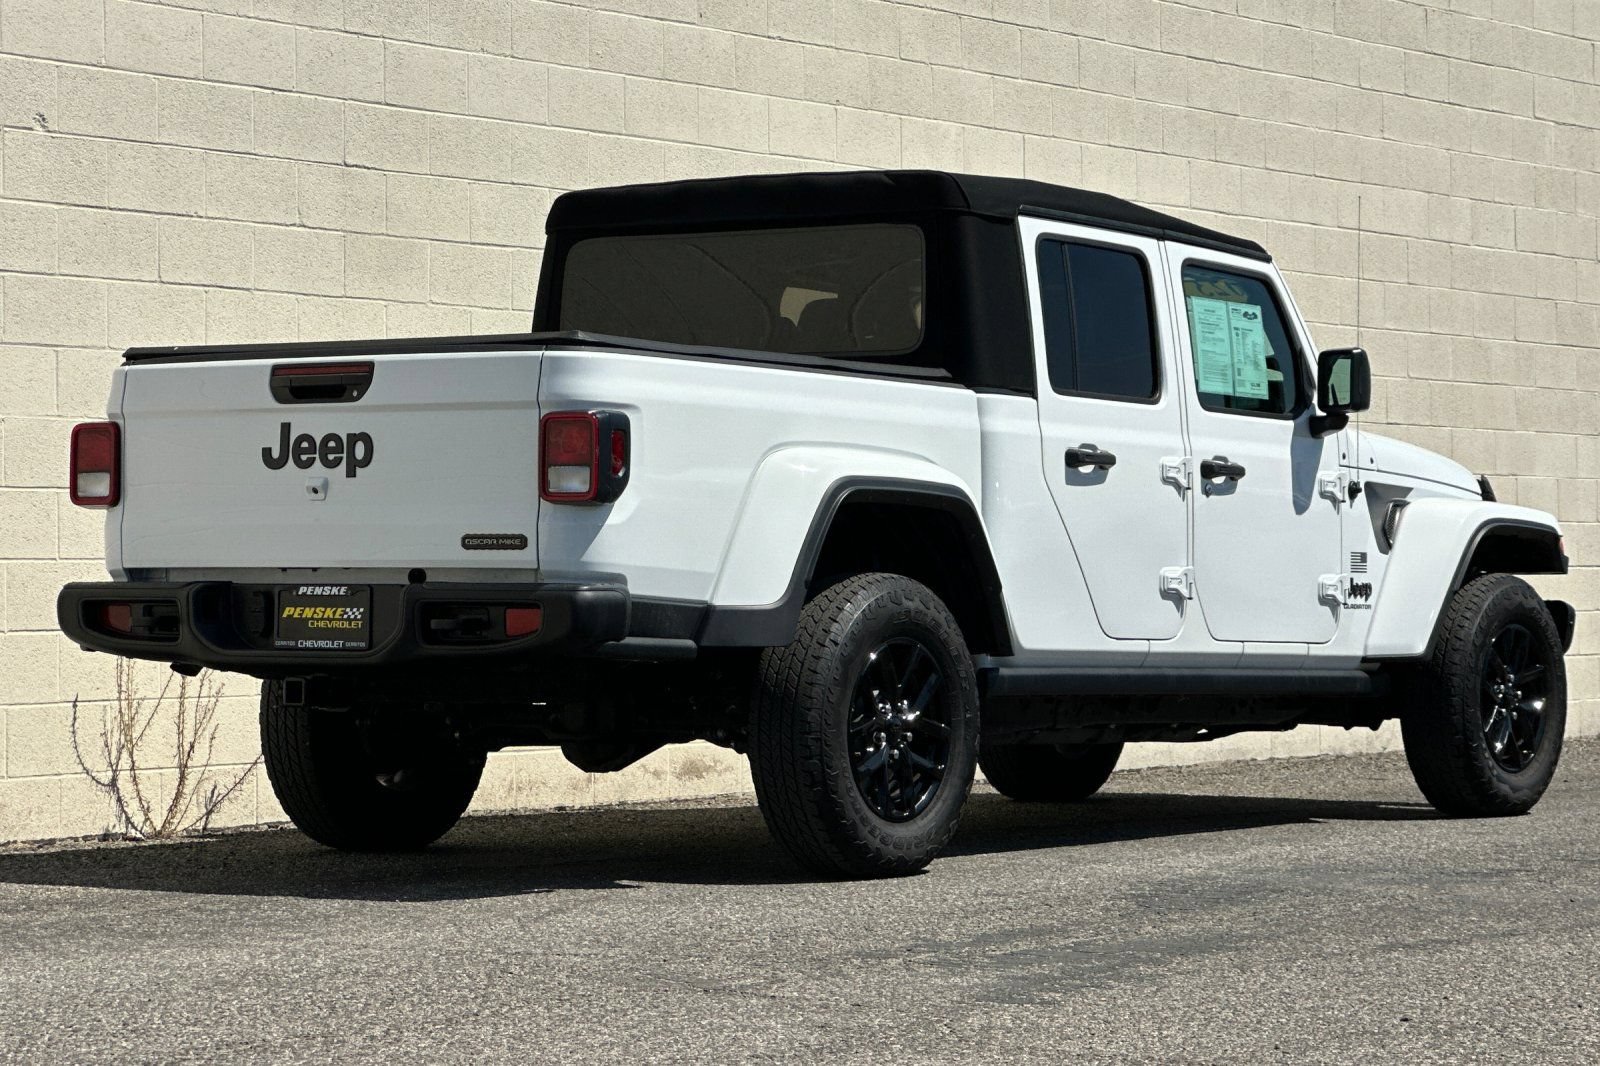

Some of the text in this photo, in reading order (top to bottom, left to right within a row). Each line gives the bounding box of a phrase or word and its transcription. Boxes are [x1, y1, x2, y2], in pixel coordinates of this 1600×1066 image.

[261, 422, 374, 478] Jeep
[298, 586, 347, 595] PENSKE
[1347, 577, 1372, 602] Jeep
[282, 607, 345, 618] PENSKE
[308, 620, 363, 629] CHEVROLET
[297, 640, 344, 648] CHEVROLET
